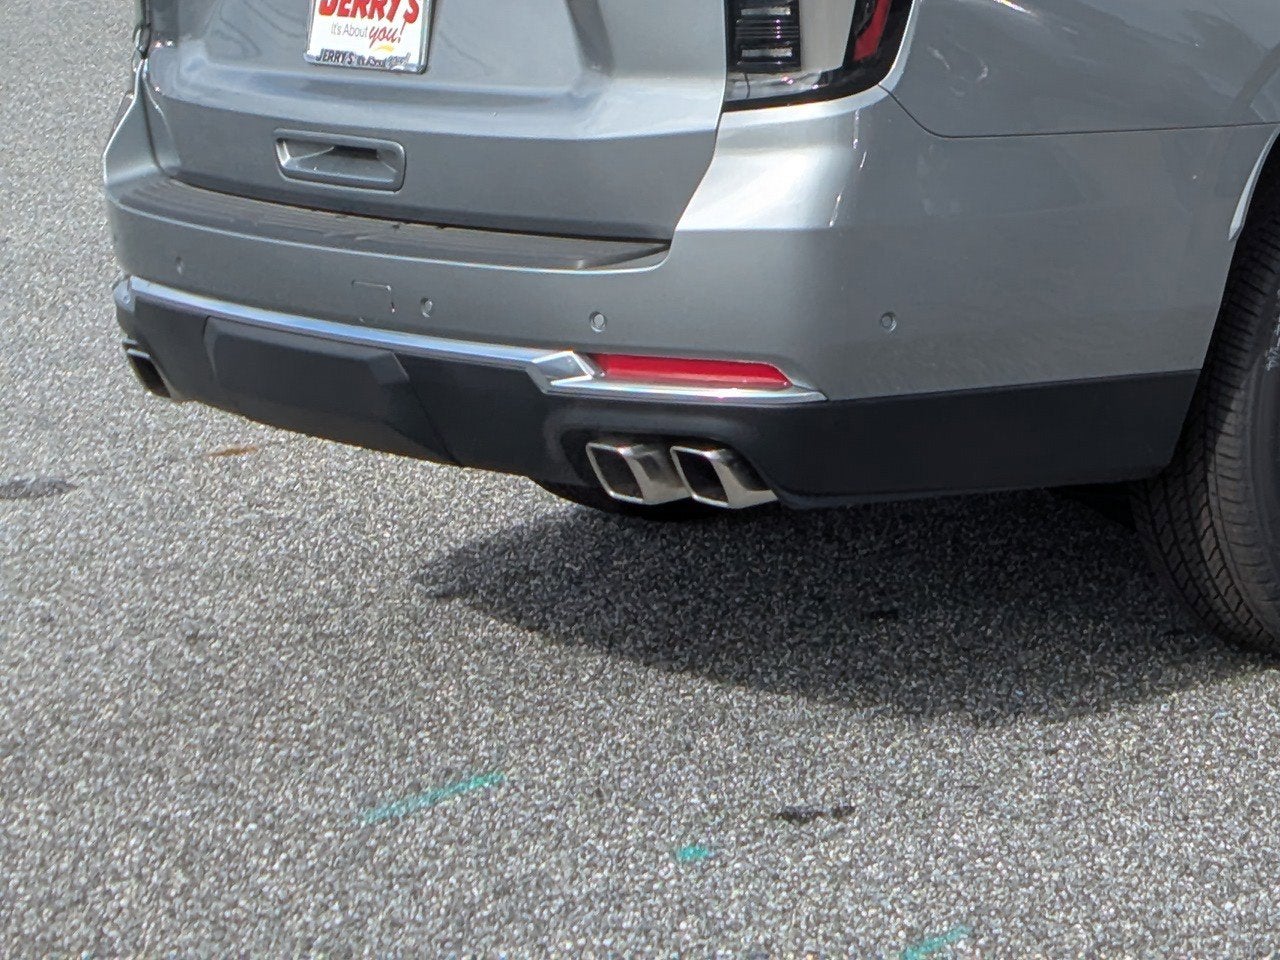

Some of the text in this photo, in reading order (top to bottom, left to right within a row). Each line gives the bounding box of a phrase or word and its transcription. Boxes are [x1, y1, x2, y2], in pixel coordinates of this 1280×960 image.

[331, 21, 407, 48] It's About you!
